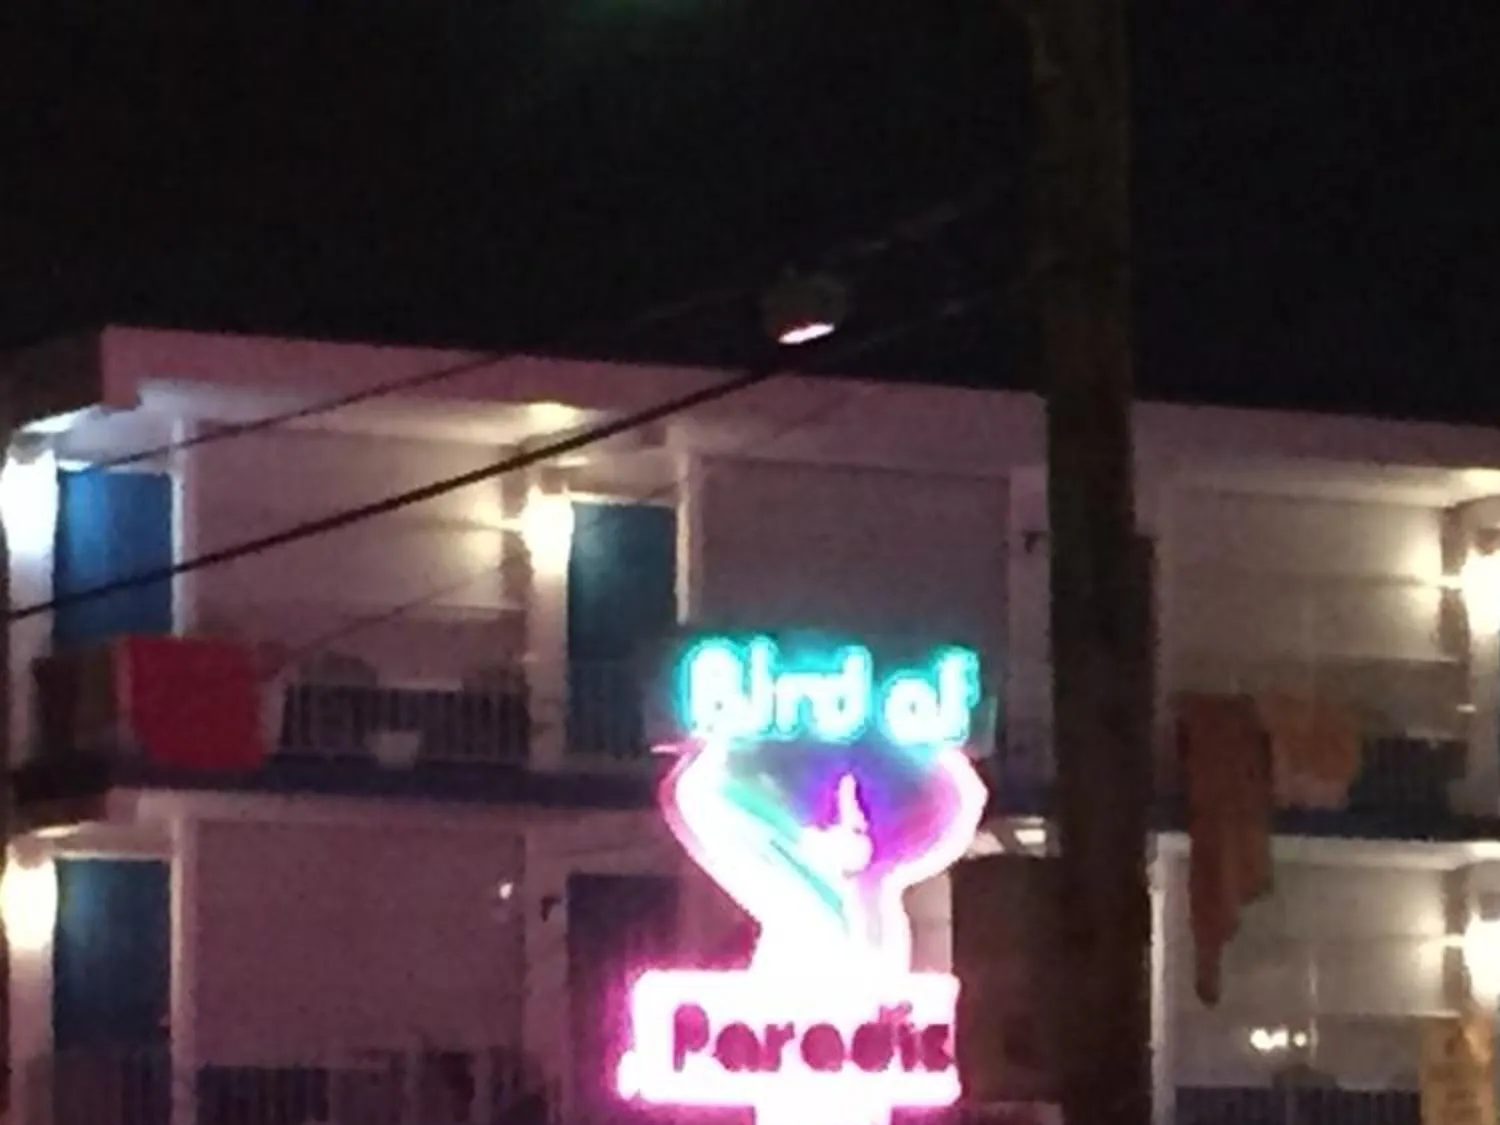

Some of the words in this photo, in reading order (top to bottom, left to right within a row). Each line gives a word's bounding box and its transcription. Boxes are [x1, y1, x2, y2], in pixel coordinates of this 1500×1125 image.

[680, 636, 871, 741] Bird
[882, 648, 979, 744] of
[673, 1002, 954, 1072] Paradis
